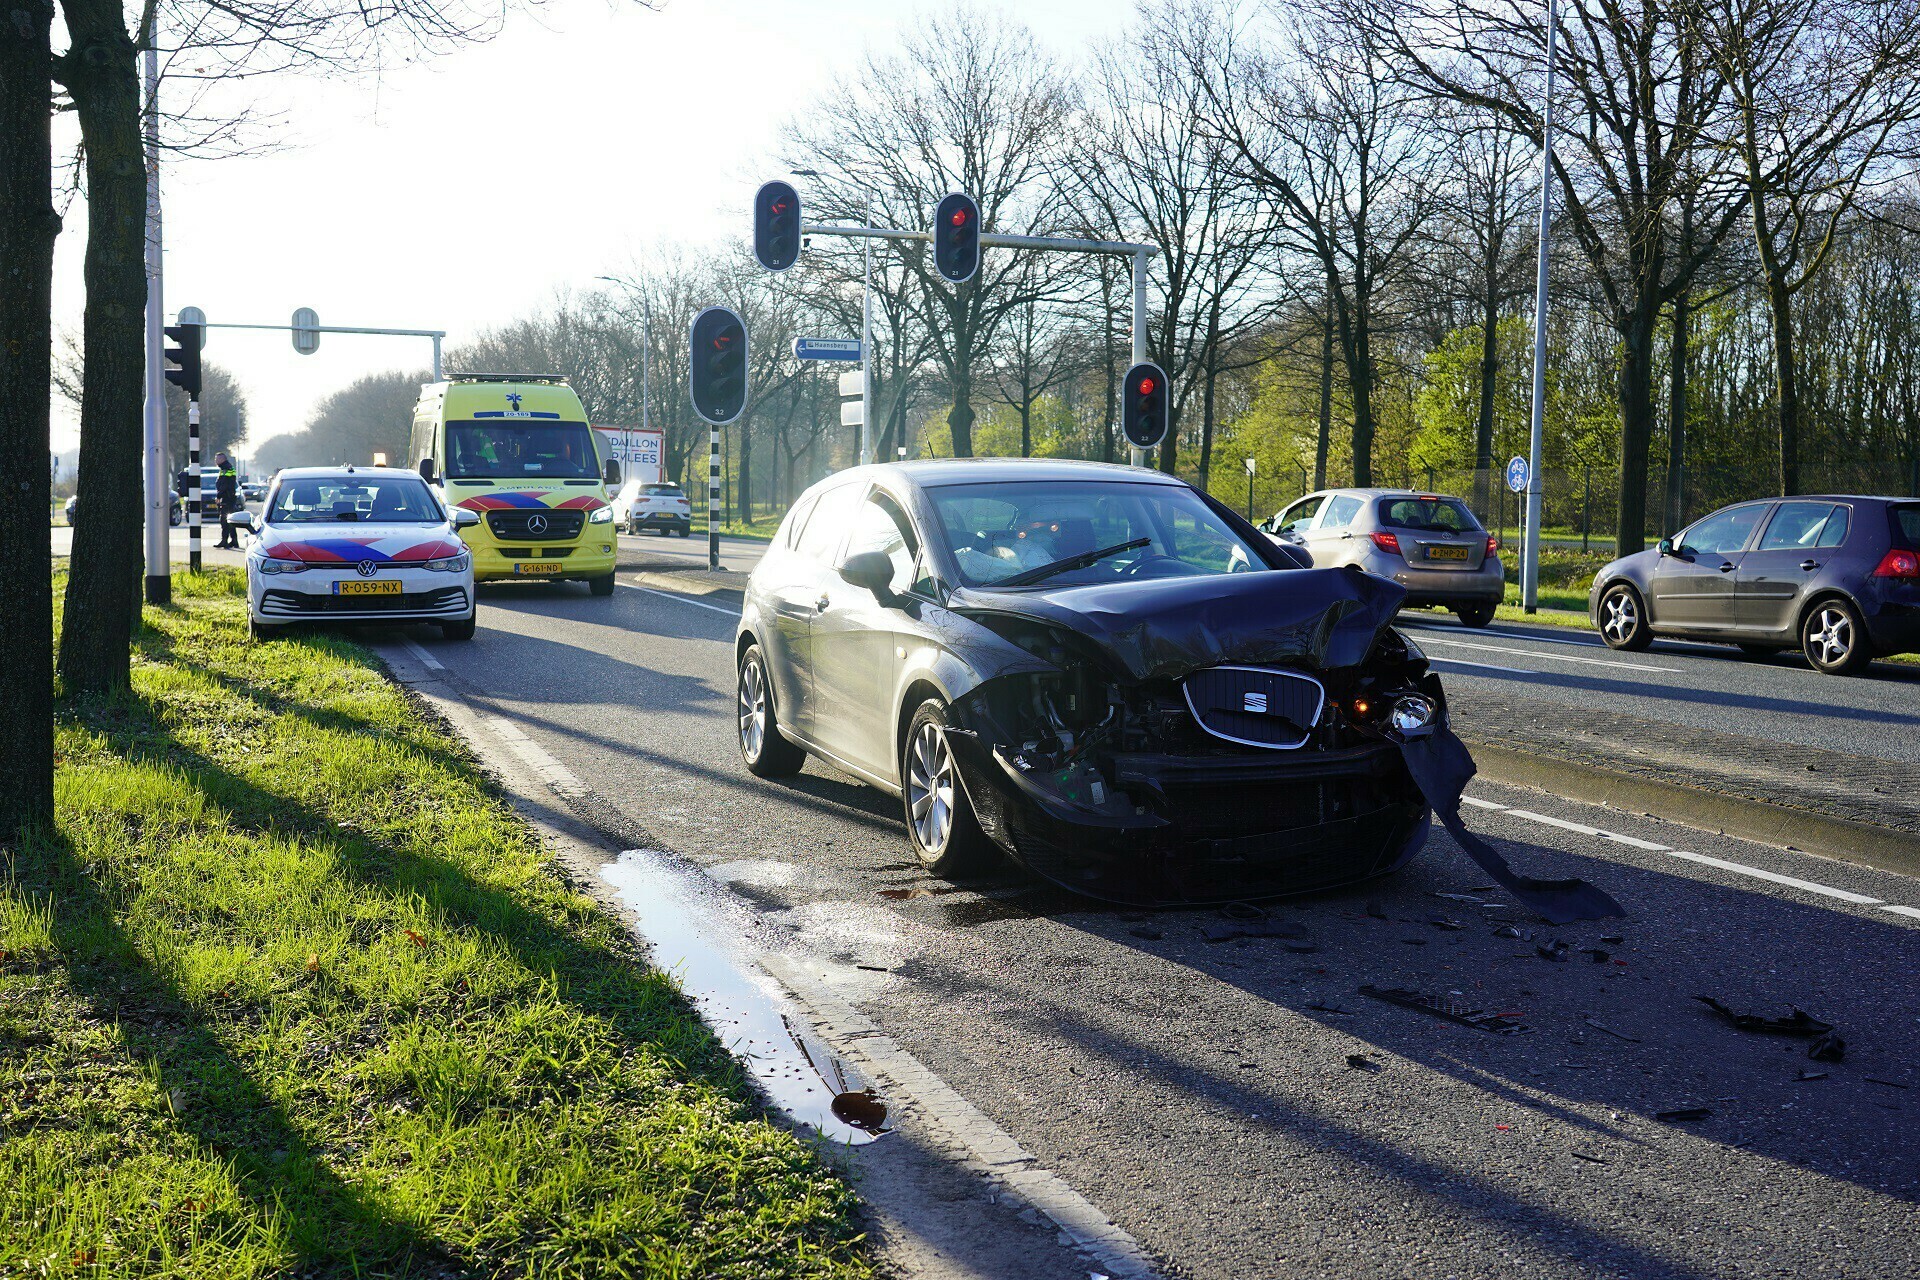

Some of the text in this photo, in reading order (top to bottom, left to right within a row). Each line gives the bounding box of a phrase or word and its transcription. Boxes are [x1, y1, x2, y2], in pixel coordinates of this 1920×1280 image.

[814, 342, 848, 350] Haansberg
[608, 437, 658, 448] DAILLON
[523, 564, 558, 573] G-161-ND
[341, 582, 399, 594] R-059-NX
